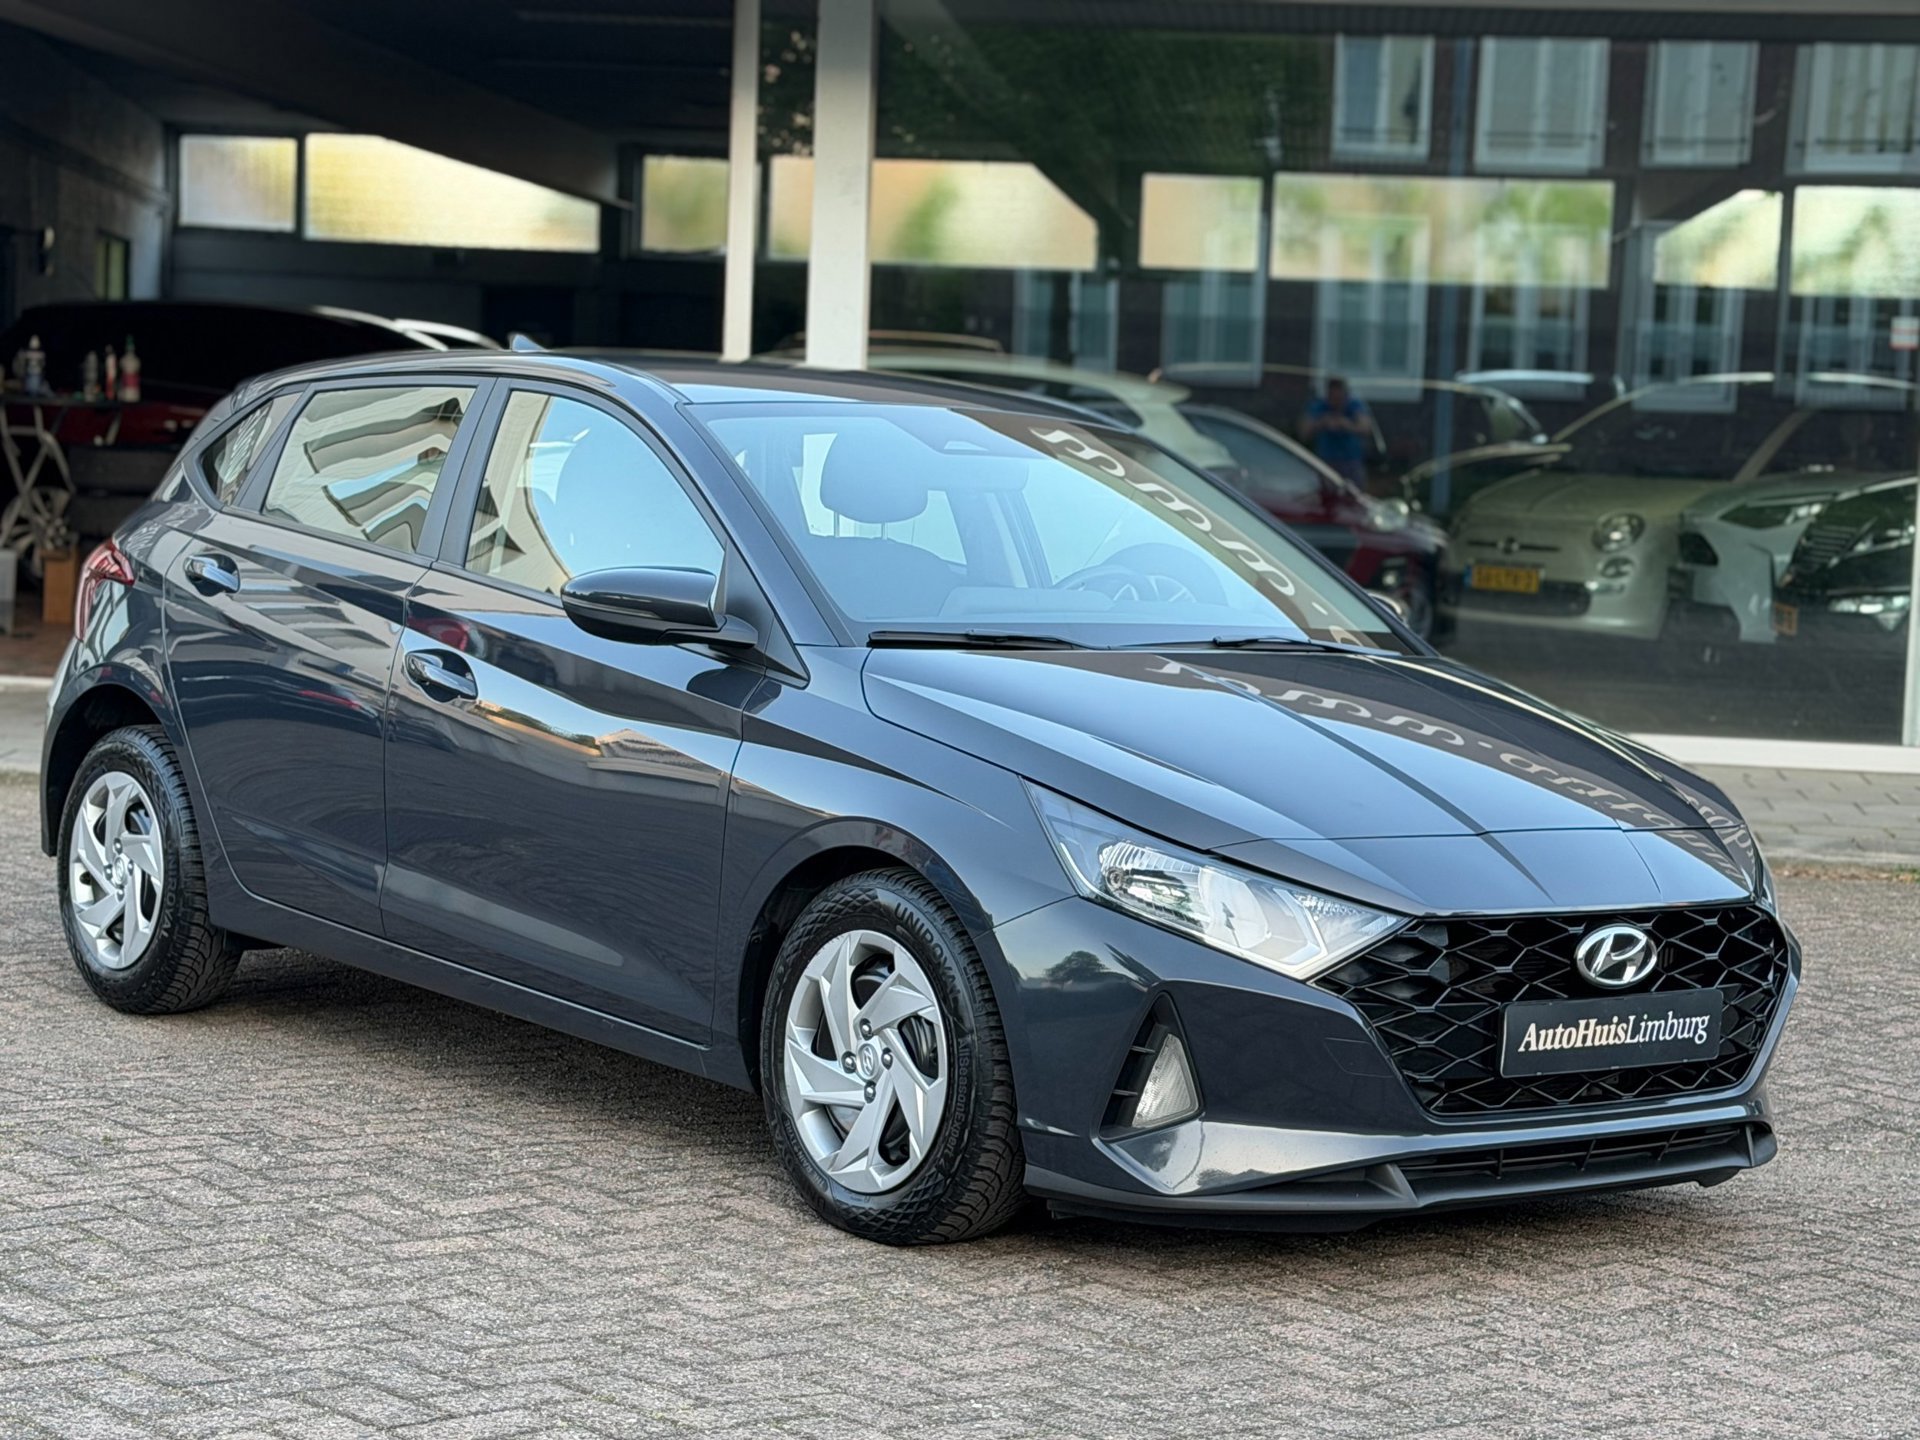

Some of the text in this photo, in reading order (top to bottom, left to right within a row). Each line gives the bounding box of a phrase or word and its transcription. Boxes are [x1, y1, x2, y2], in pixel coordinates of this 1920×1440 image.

[159, 840, 177, 941] UNIROYAL
[894, 902, 960, 1004] UNIROYAL
[1517, 1010, 1711, 1053] AutoHuisLimburg
